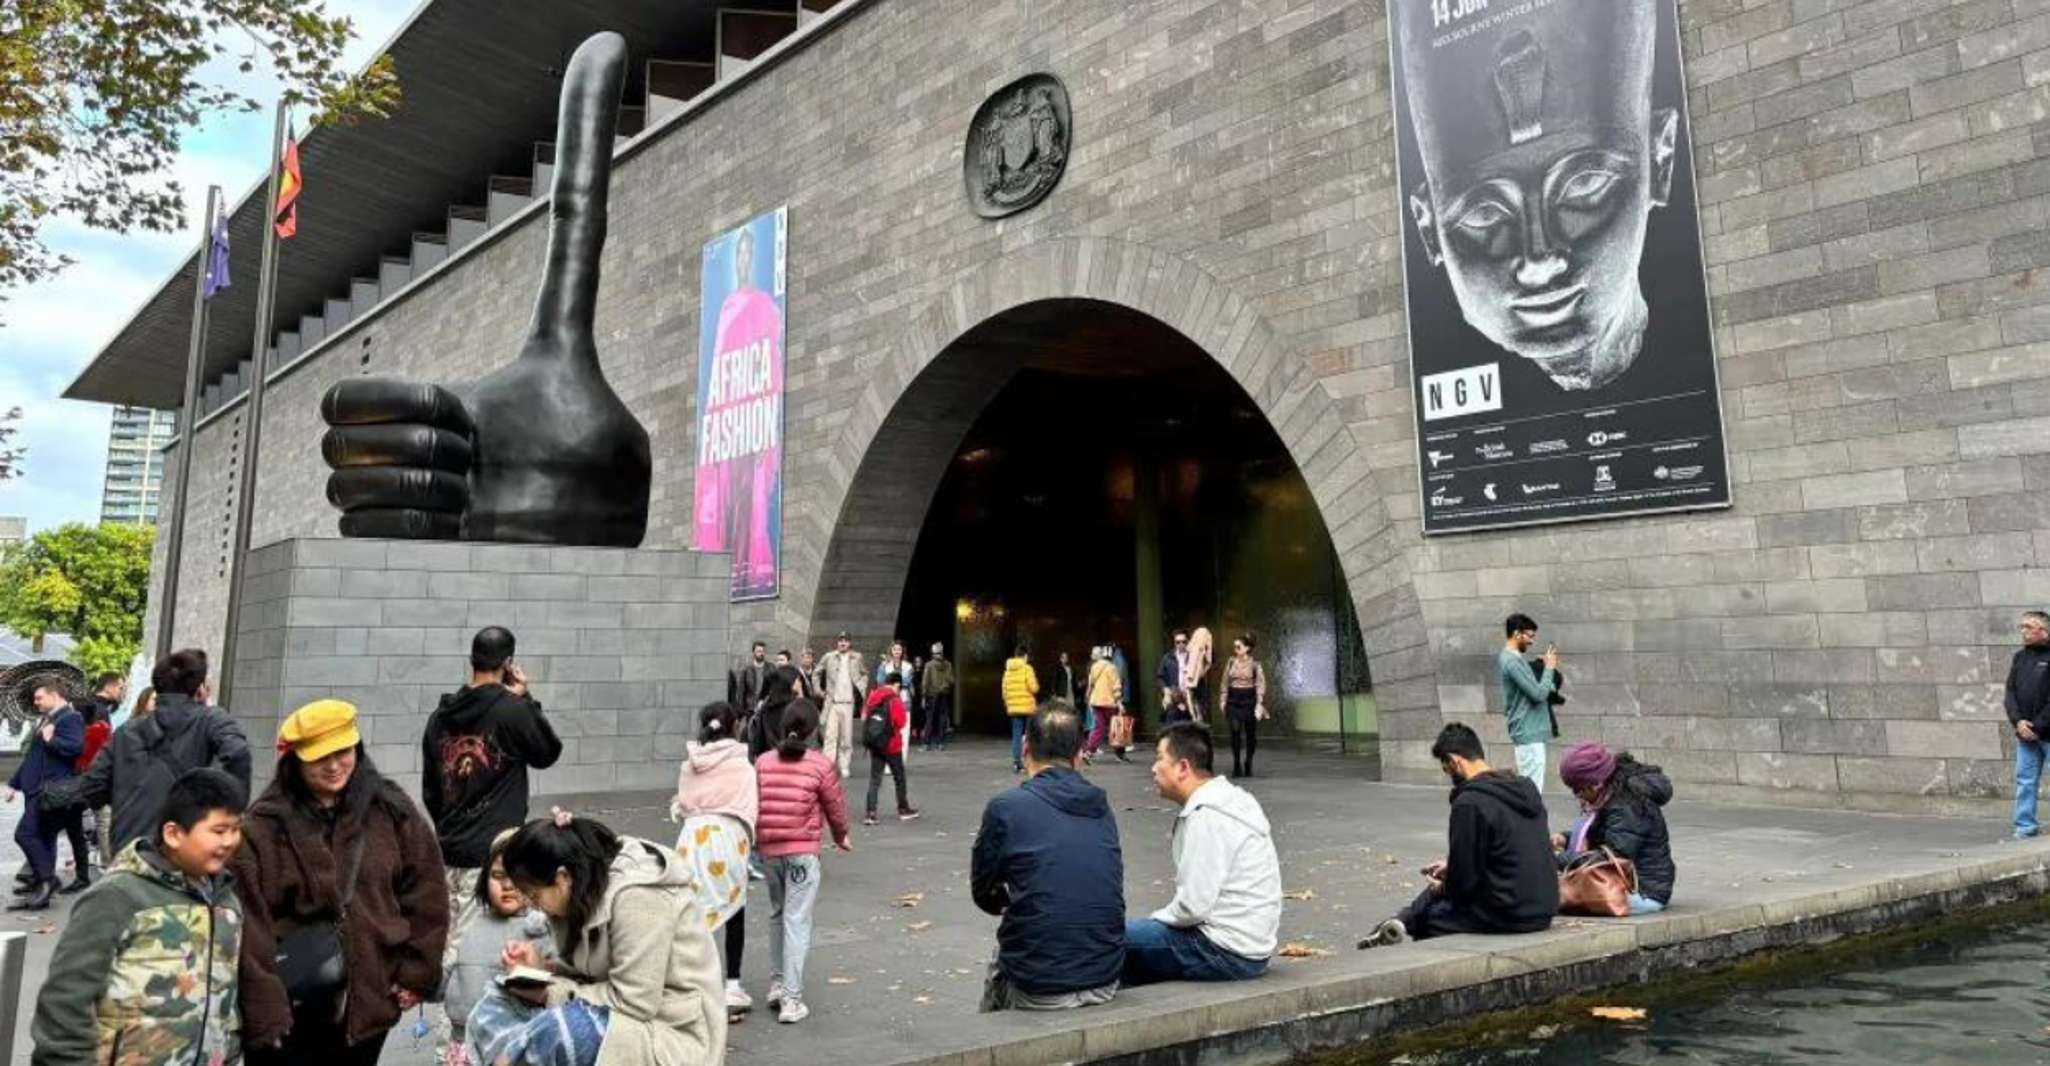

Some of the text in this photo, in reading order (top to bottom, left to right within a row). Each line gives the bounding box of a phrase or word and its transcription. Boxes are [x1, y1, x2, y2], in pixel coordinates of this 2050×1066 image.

[707, 338, 772, 408] AFRICA
[1429, 373, 1493, 412] NGV
[701, 393, 779, 465] FASHION
